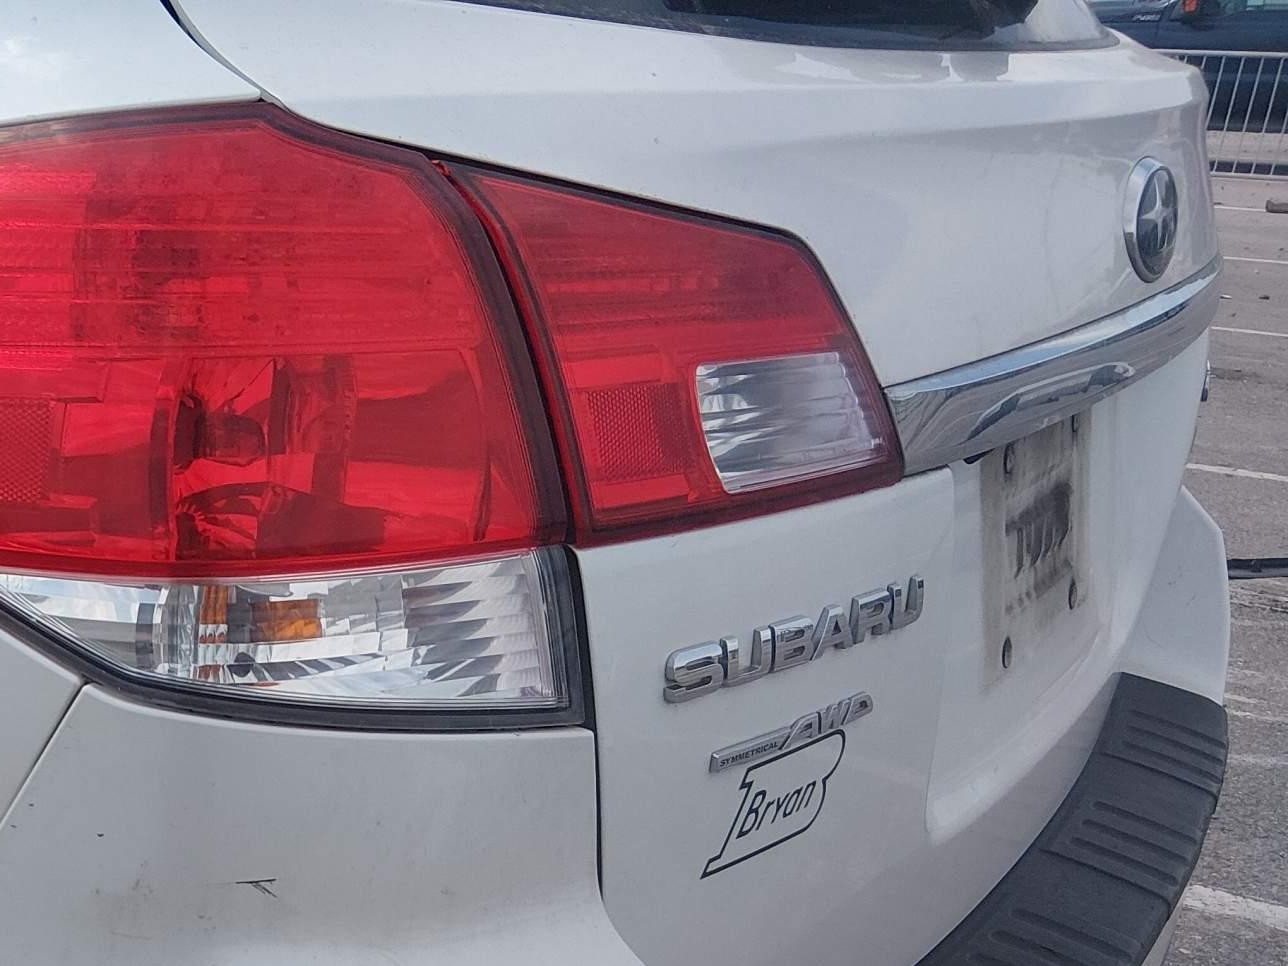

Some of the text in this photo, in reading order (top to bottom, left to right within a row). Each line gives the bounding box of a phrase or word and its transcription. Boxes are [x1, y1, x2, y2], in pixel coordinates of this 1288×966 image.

[663, 574, 924, 704] SUBARU
[719, 691, 874, 768] SYMMETRICAL AWD
[736, 780, 817, 839] Bryan
